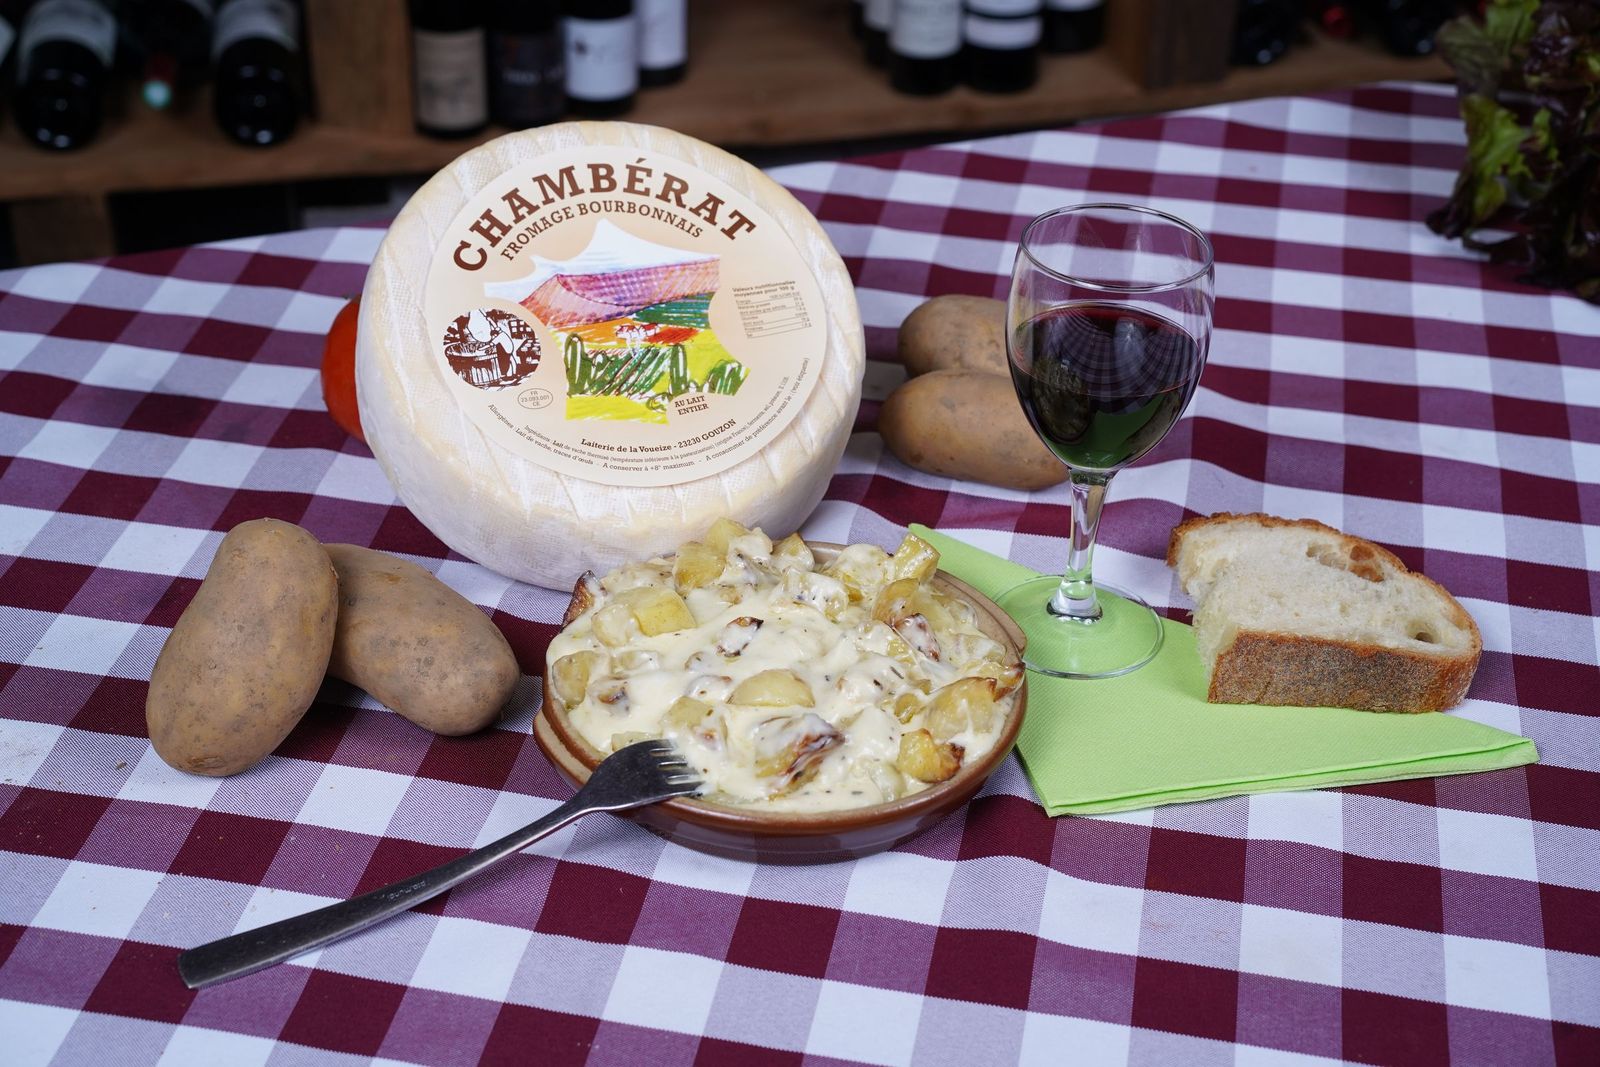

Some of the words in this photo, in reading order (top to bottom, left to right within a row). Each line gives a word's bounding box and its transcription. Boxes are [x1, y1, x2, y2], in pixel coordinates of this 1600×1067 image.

[453, 158, 757, 271] CHAMBÉRAT
[500, 206, 580, 261] FROMAGE
[578, 200, 703, 239] BOURBONNAIS
[674, 400, 686, 408] AU
[686, 395, 706, 405] LAIT
[677, 403, 709, 416] ENTIER
[515, 427, 527, 438] Lait
[526, 434, 535, 442] de
[553, 448, 572, 459] traces
[552, 440, 564, 449] Lait
[580, 438, 615, 452] Laiterie
[639, 443, 672, 453] Voueize
[677, 436, 701, 449] 23230
[701, 418, 737, 442] GOUZON
[711, 440, 745, 459] consommer
[744, 434, 754, 443] de
[609, 464, 643, 472] conserver
[662, 460, 695, 471] maximum
